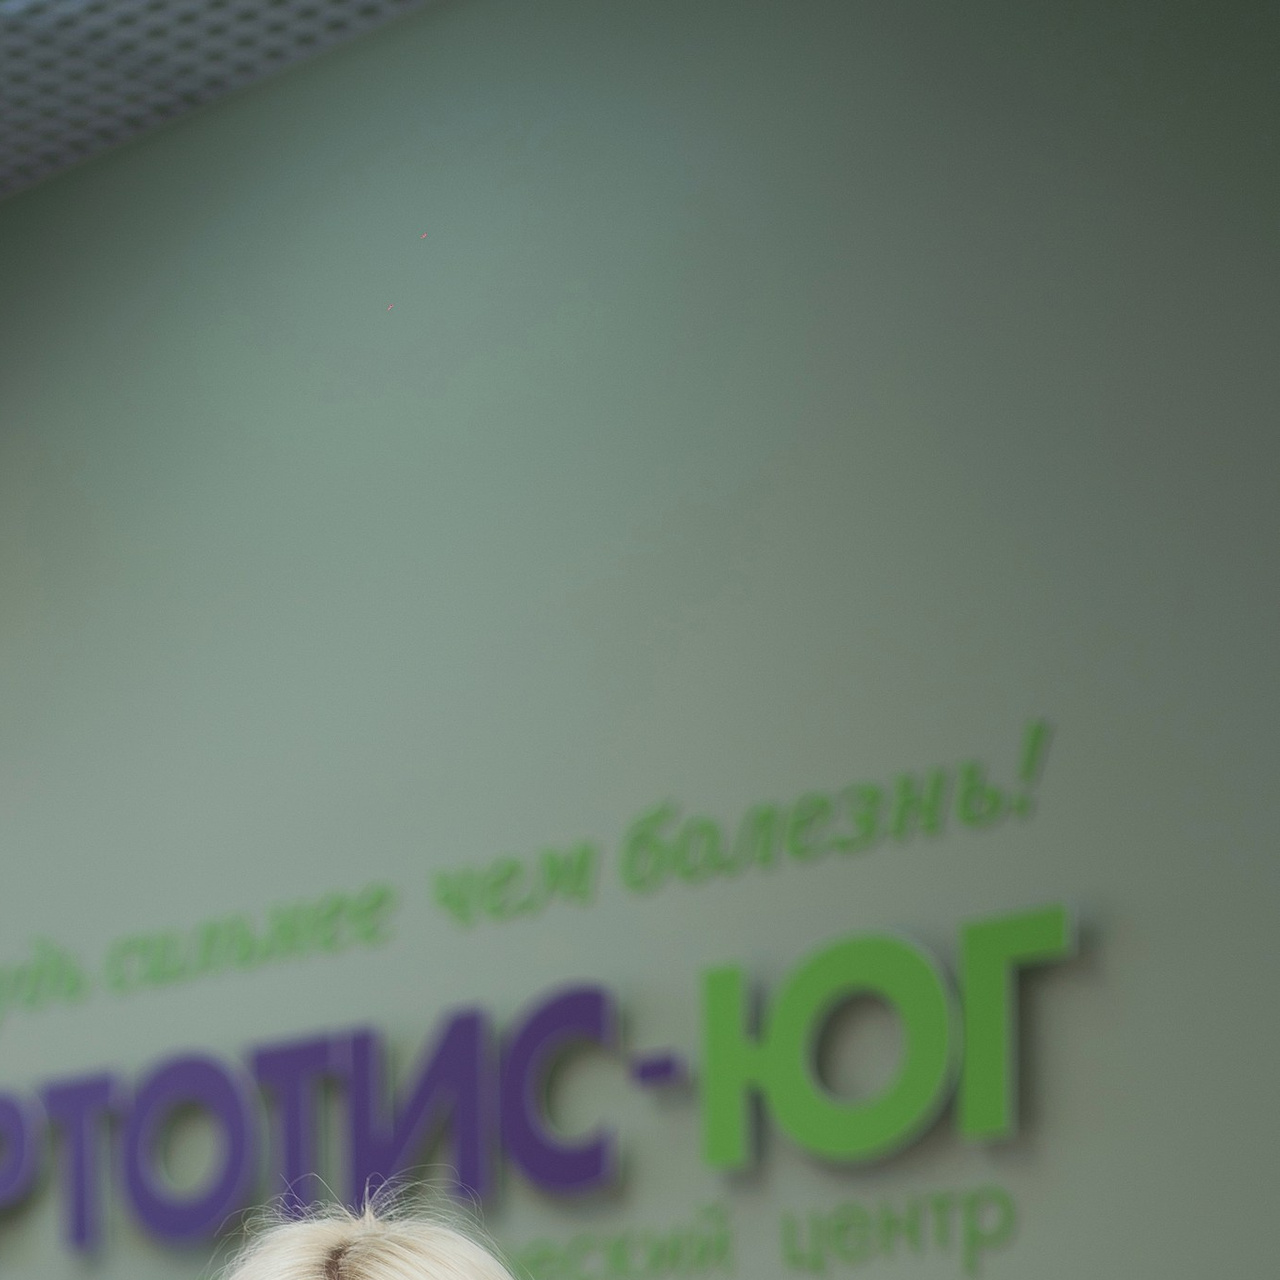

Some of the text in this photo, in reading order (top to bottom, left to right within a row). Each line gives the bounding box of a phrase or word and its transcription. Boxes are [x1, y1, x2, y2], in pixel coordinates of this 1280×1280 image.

[426, 836, 601, 930] чем
[614, 719, 1051, 895] болезнь!
[778, 1181, 1017, 1280] центр
